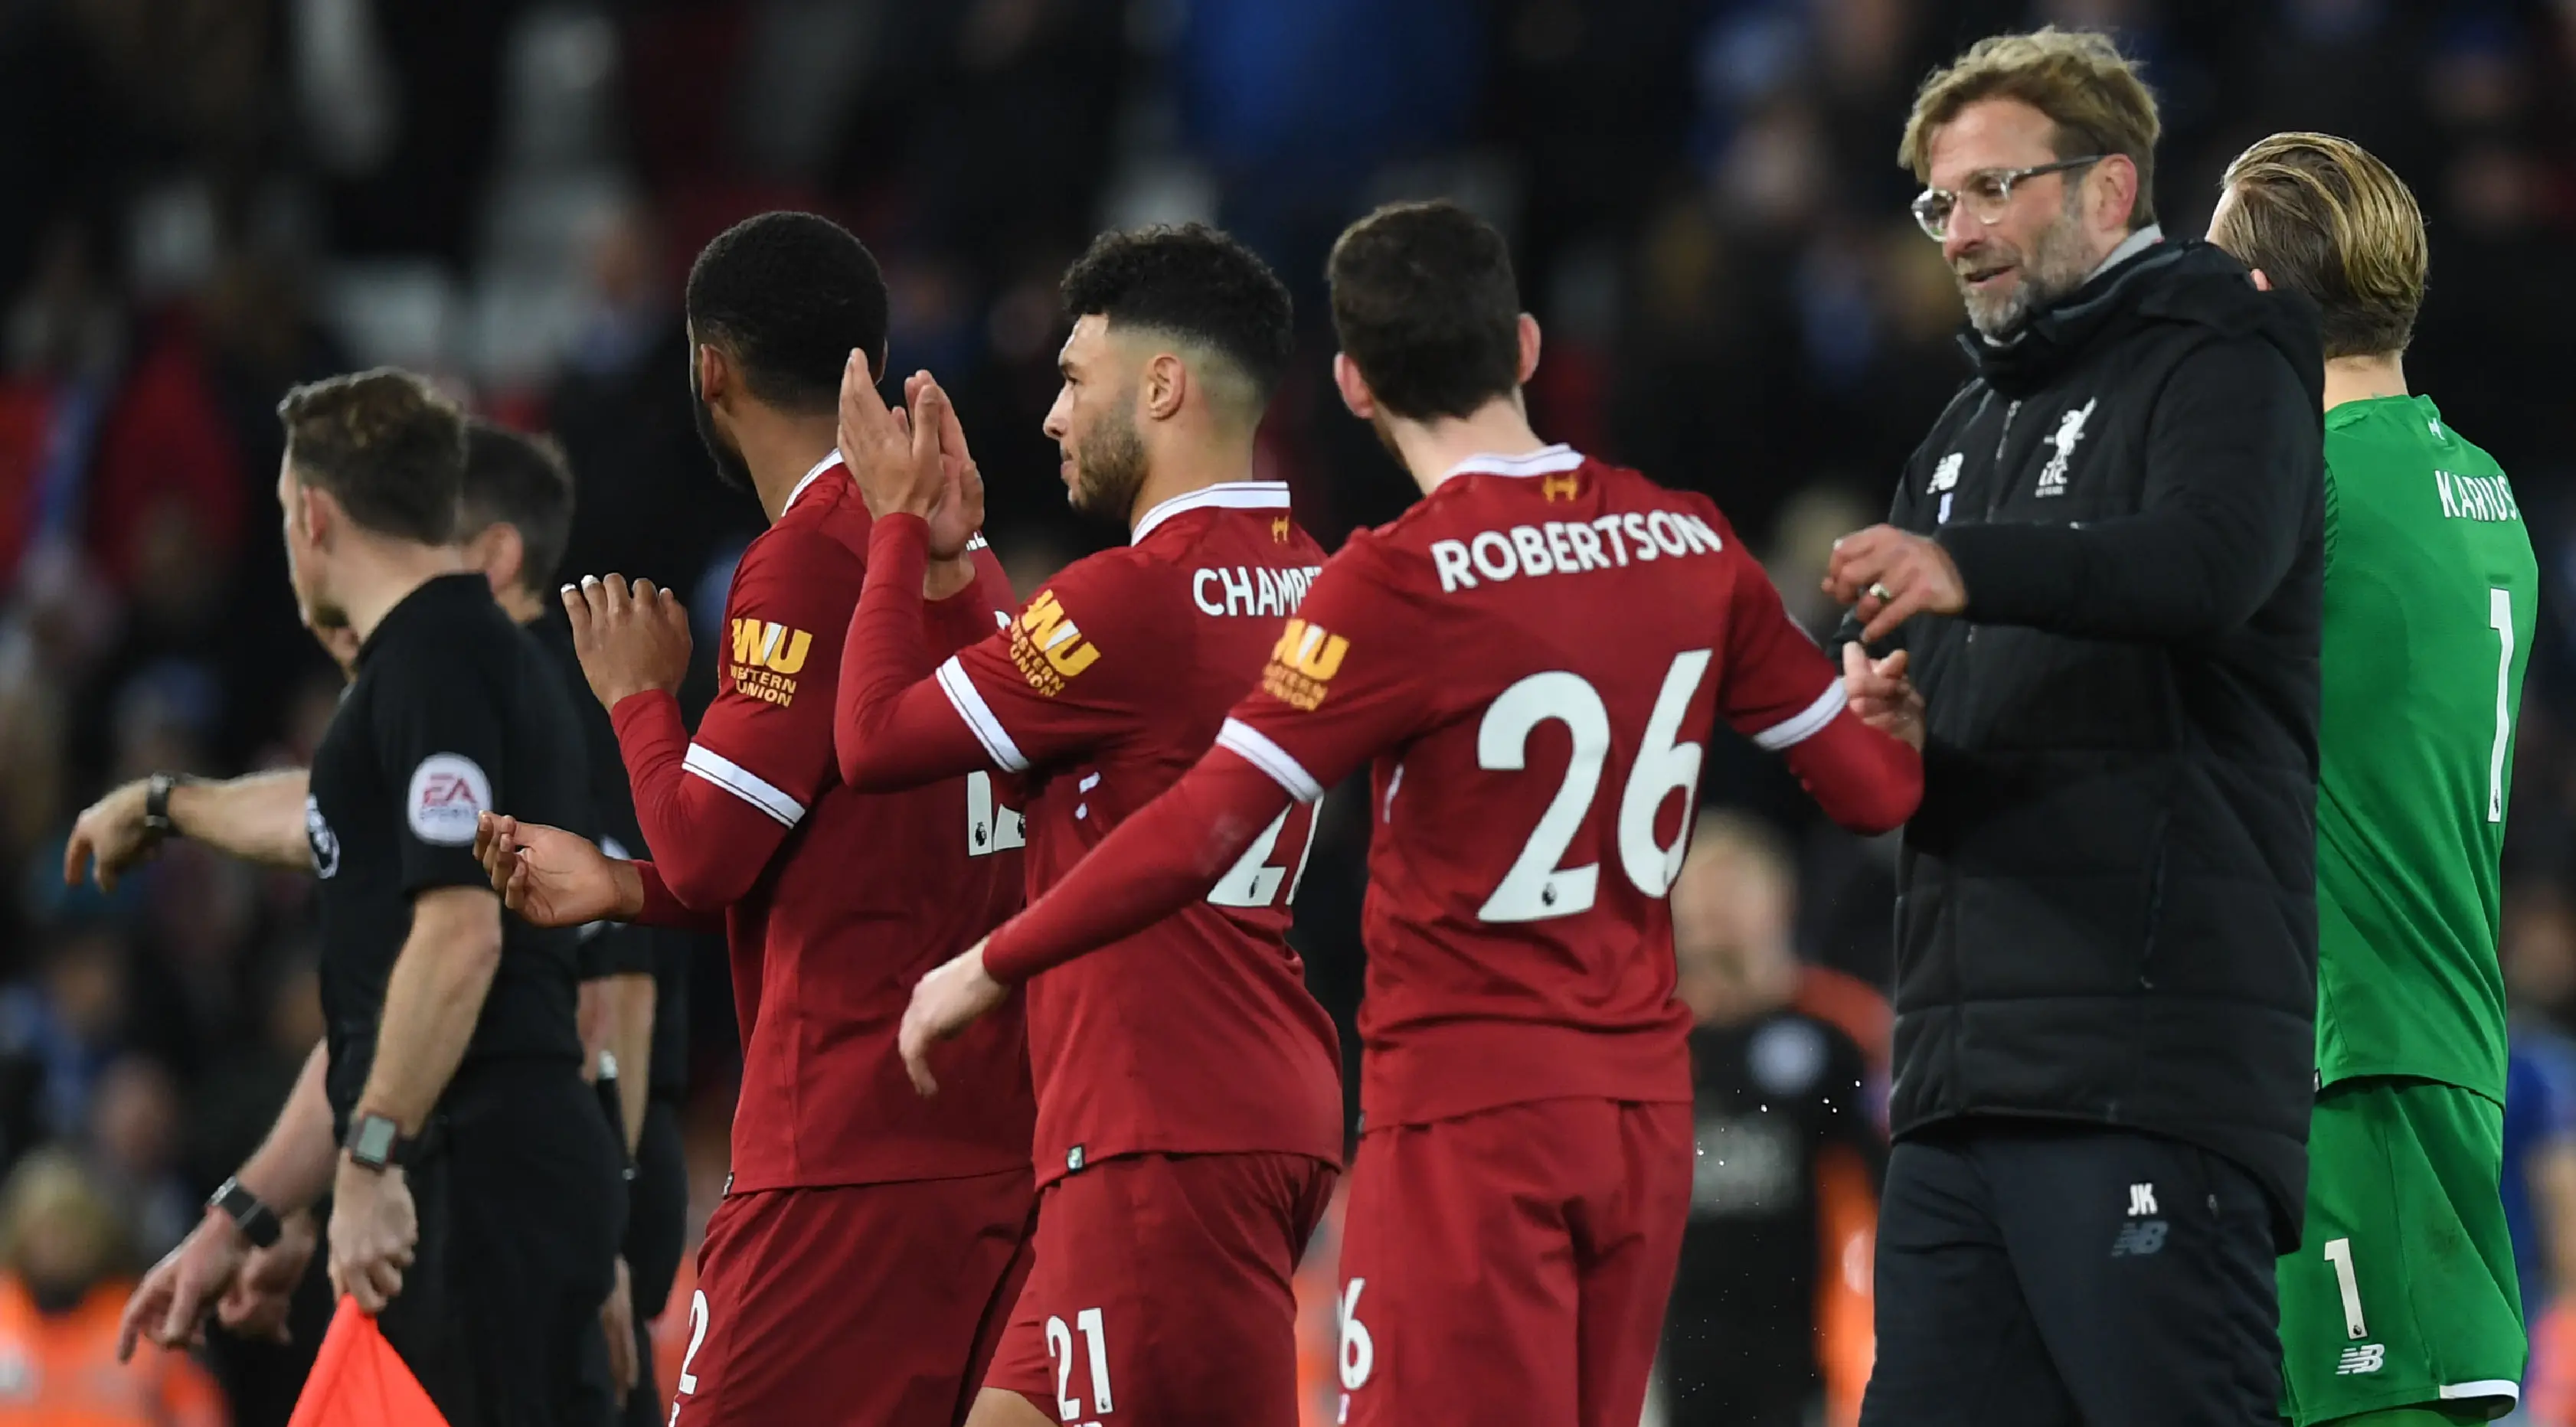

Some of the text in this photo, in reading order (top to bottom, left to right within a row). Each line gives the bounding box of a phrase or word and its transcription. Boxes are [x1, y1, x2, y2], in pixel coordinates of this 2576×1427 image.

[2434, 469, 2517, 521] KARIUS
[1430, 508, 1723, 593] ROBERTSON
[731, 618, 813, 674] WU
[1009, 643, 1056, 697] UNION
[1021, 588, 1101, 677] WU
[736, 680, 793, 707] UNION
[2487, 587, 2515, 823] 1
[423, 772, 478, 807] EA
[1477, 648, 1713, 922] 26
[2127, 1182, 2159, 1216] JK
[2323, 1237, 2368, 1340] 1
[1045, 1306, 1114, 1422] 21
[1336, 1276, 1375, 1391] 6
